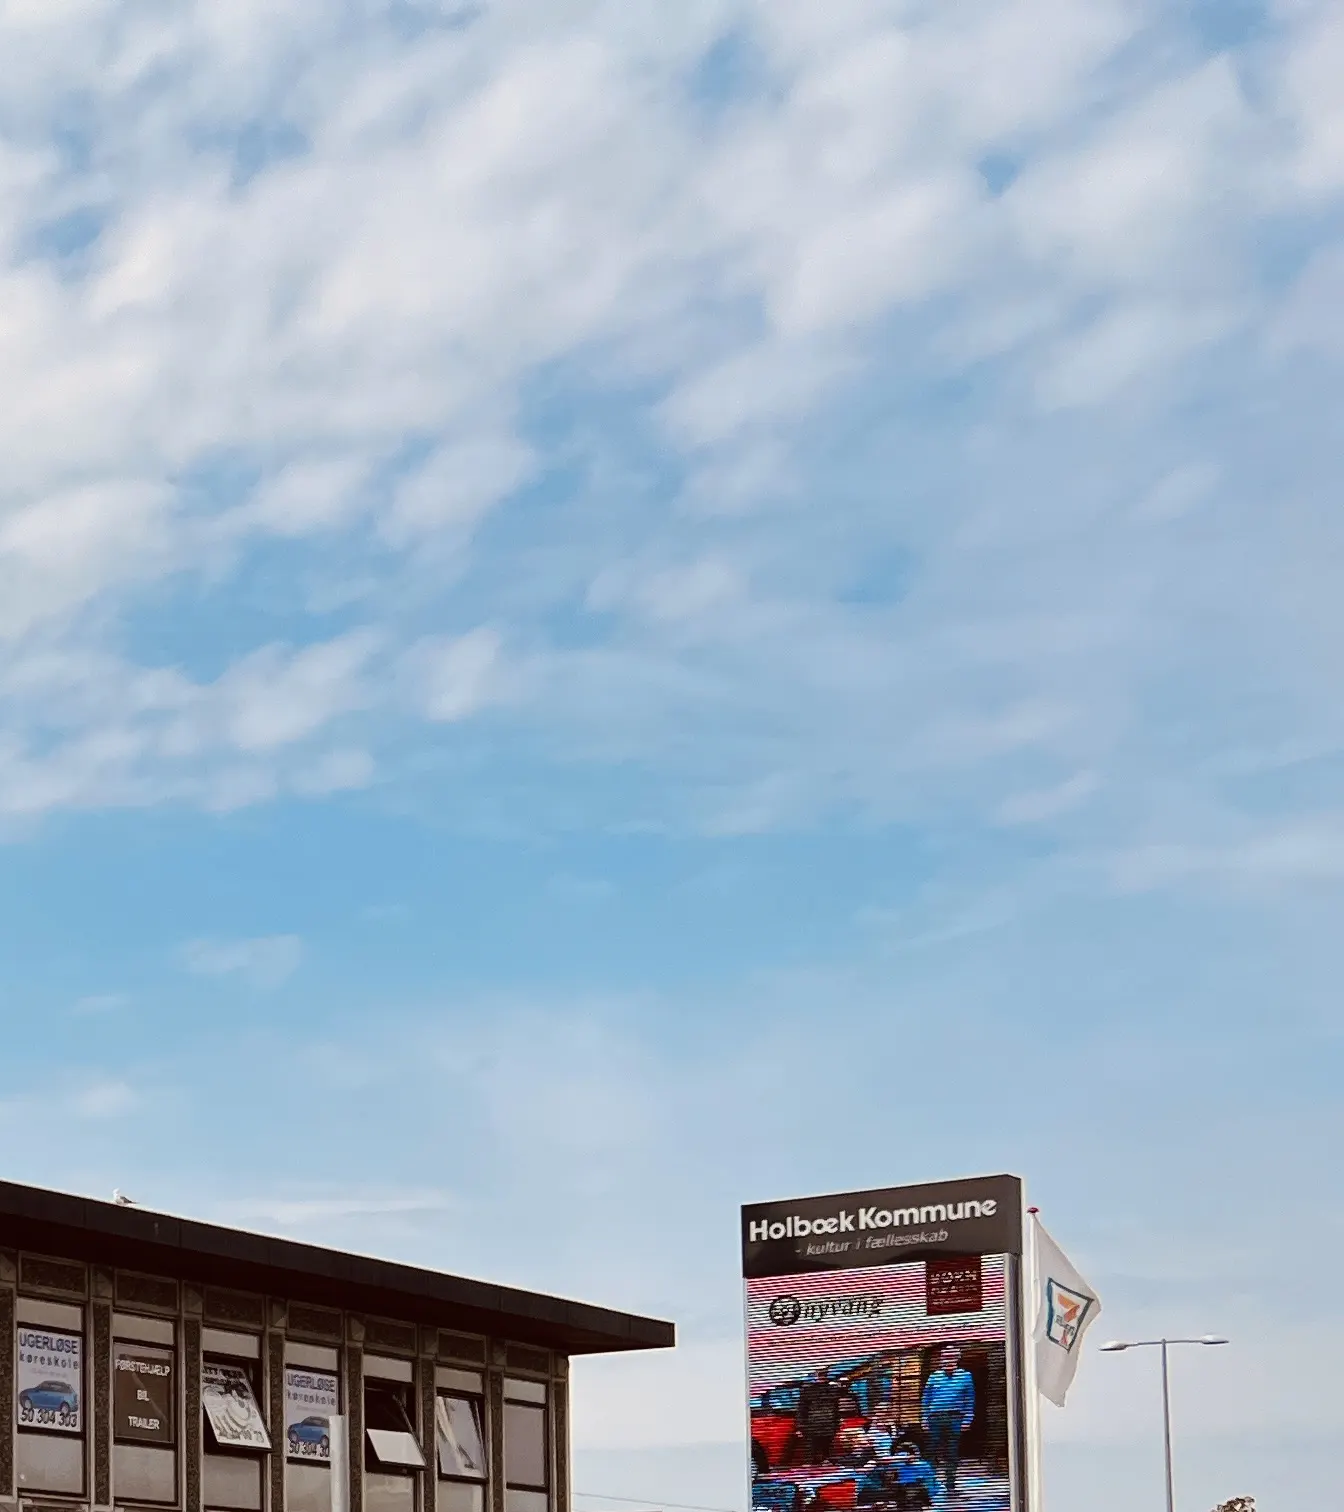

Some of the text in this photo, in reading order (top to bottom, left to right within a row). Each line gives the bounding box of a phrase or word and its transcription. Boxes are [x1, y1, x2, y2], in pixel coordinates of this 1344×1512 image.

[749, 1199, 998, 1242] Holbæk Kommune
[806, 1238, 850, 1256] kultur
[864, 1228, 949, 1250] fællesskab
[19, 1332, 79, 1355] UGERLØSE
